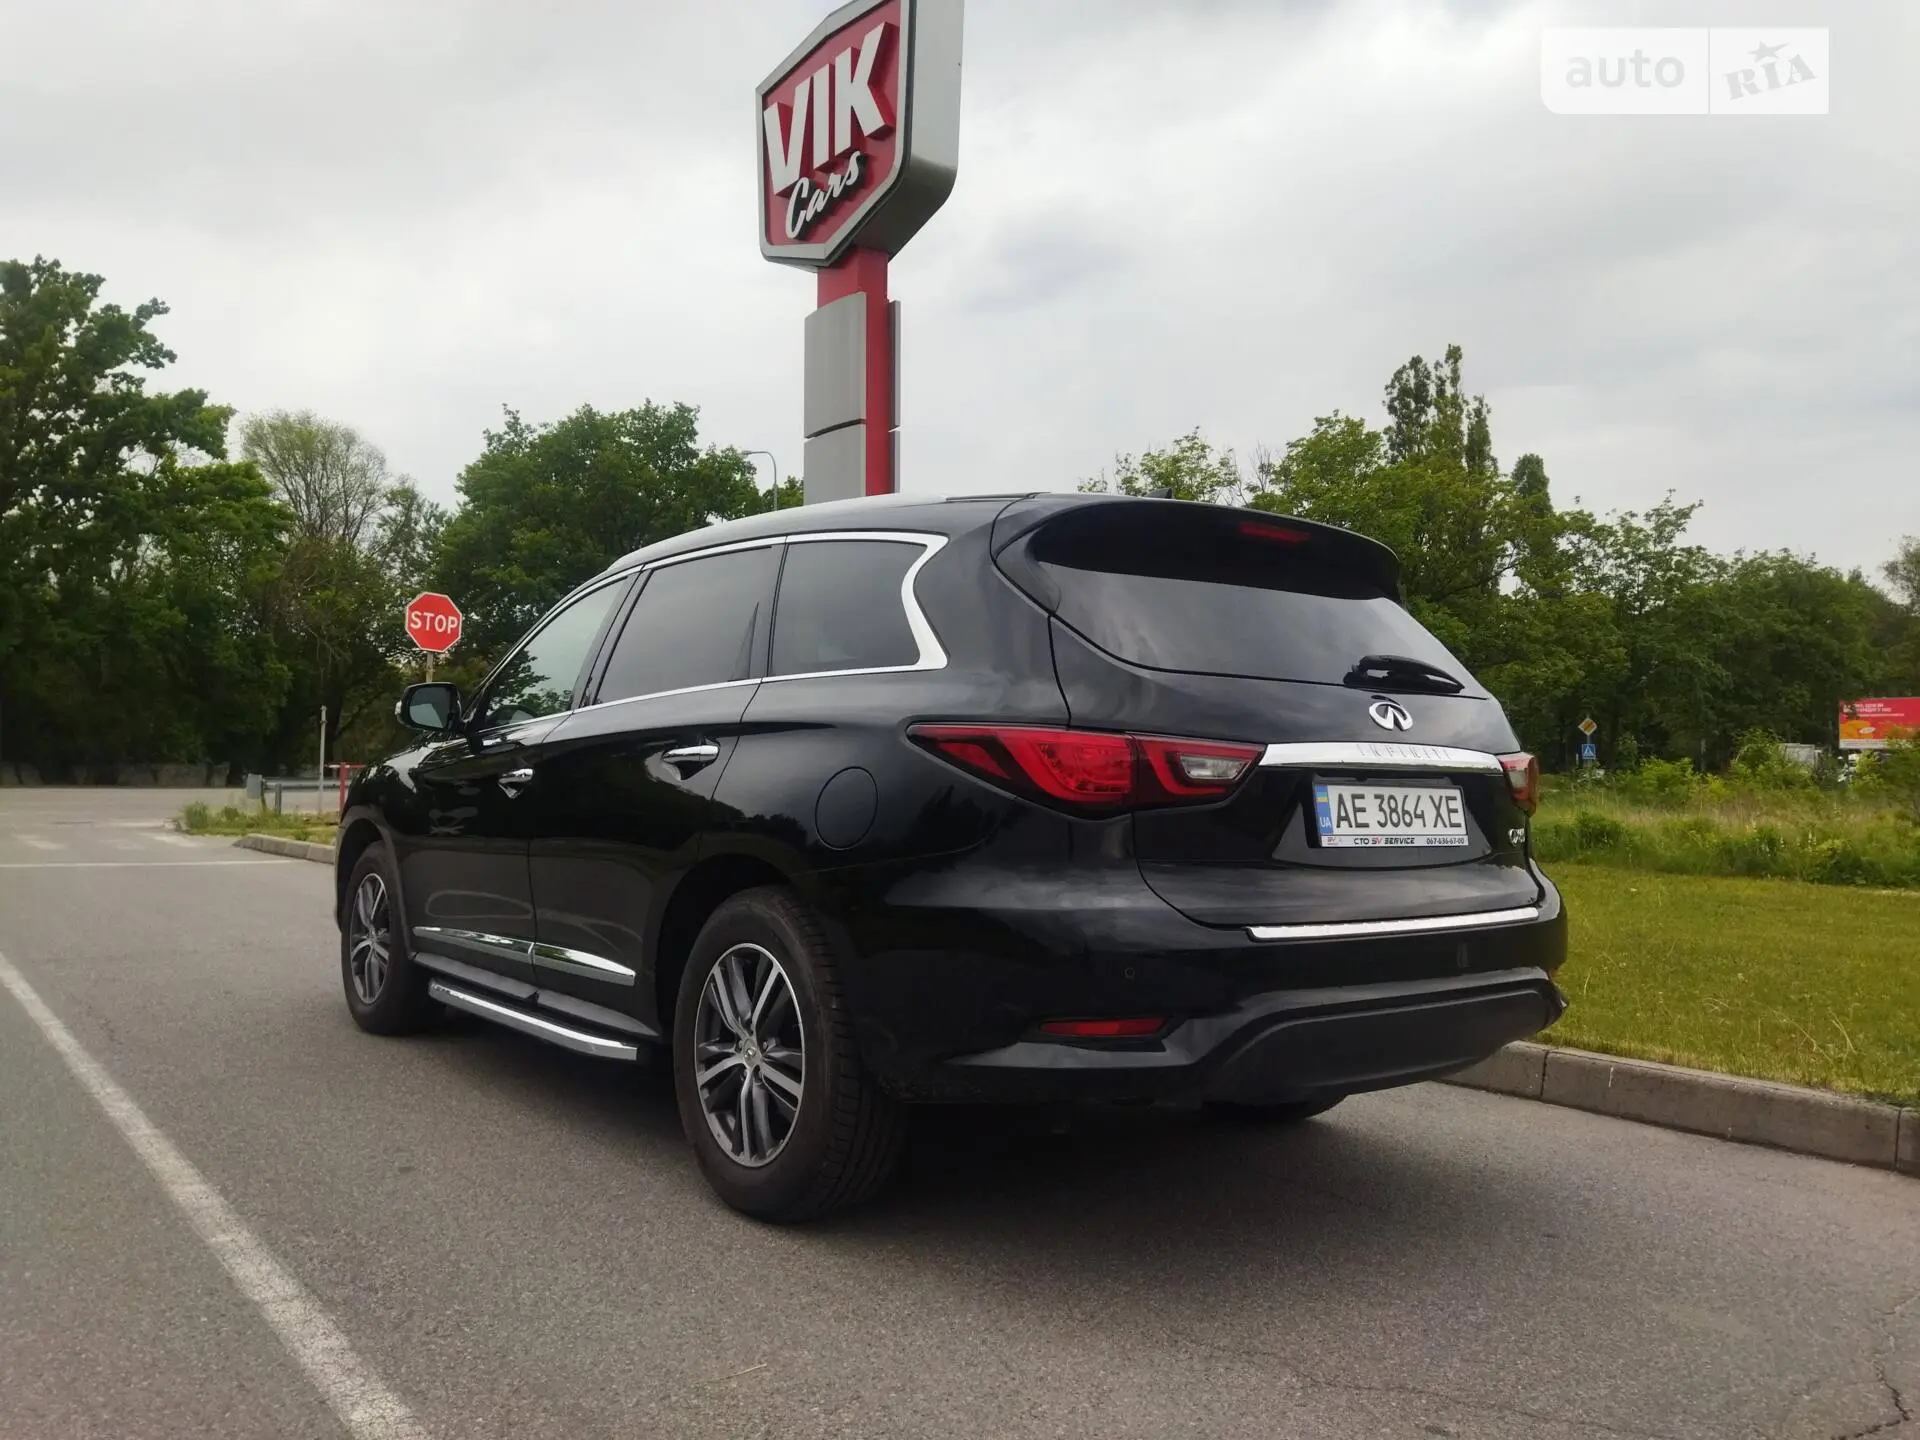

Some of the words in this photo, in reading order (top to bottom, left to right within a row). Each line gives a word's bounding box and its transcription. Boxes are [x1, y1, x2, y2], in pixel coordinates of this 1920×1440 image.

[763, 21, 886, 195] VIK
[785, 150, 861, 239] Cars
[410, 611, 458, 634] STOP
[1320, 817, 1332, 828] UA
[1336, 793, 1370, 828] AE
[1374, 794, 1426, 829] 3864
[1429, 794, 1462, 828] XE
[1384, 836, 1415, 845] SERVICE
